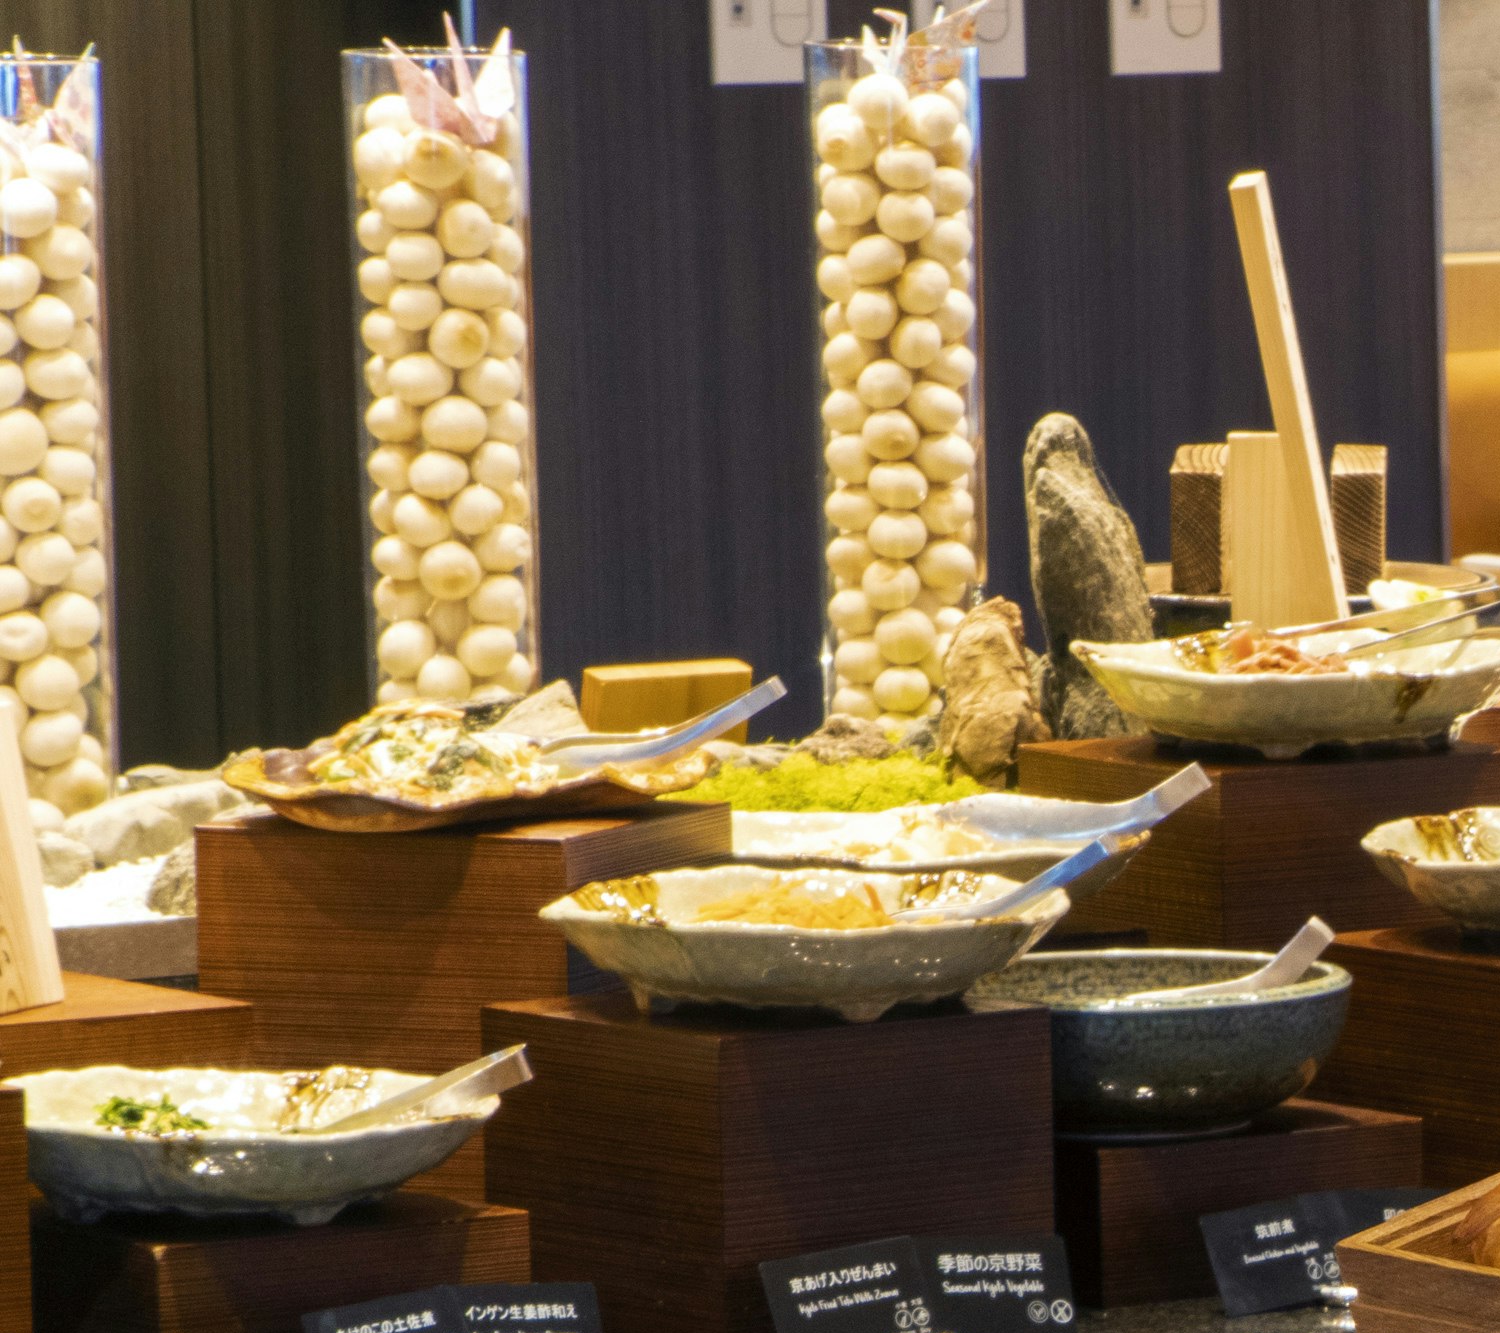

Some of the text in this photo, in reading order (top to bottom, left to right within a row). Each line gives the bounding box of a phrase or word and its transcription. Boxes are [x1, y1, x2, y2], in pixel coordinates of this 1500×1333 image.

[937, 1252, 1043, 1274] 季節の京野菜
[789, 1262, 897, 1294] 京あげ入りぜんまい
[465, 1303, 578, 1321] インゲン生姜酢和え
